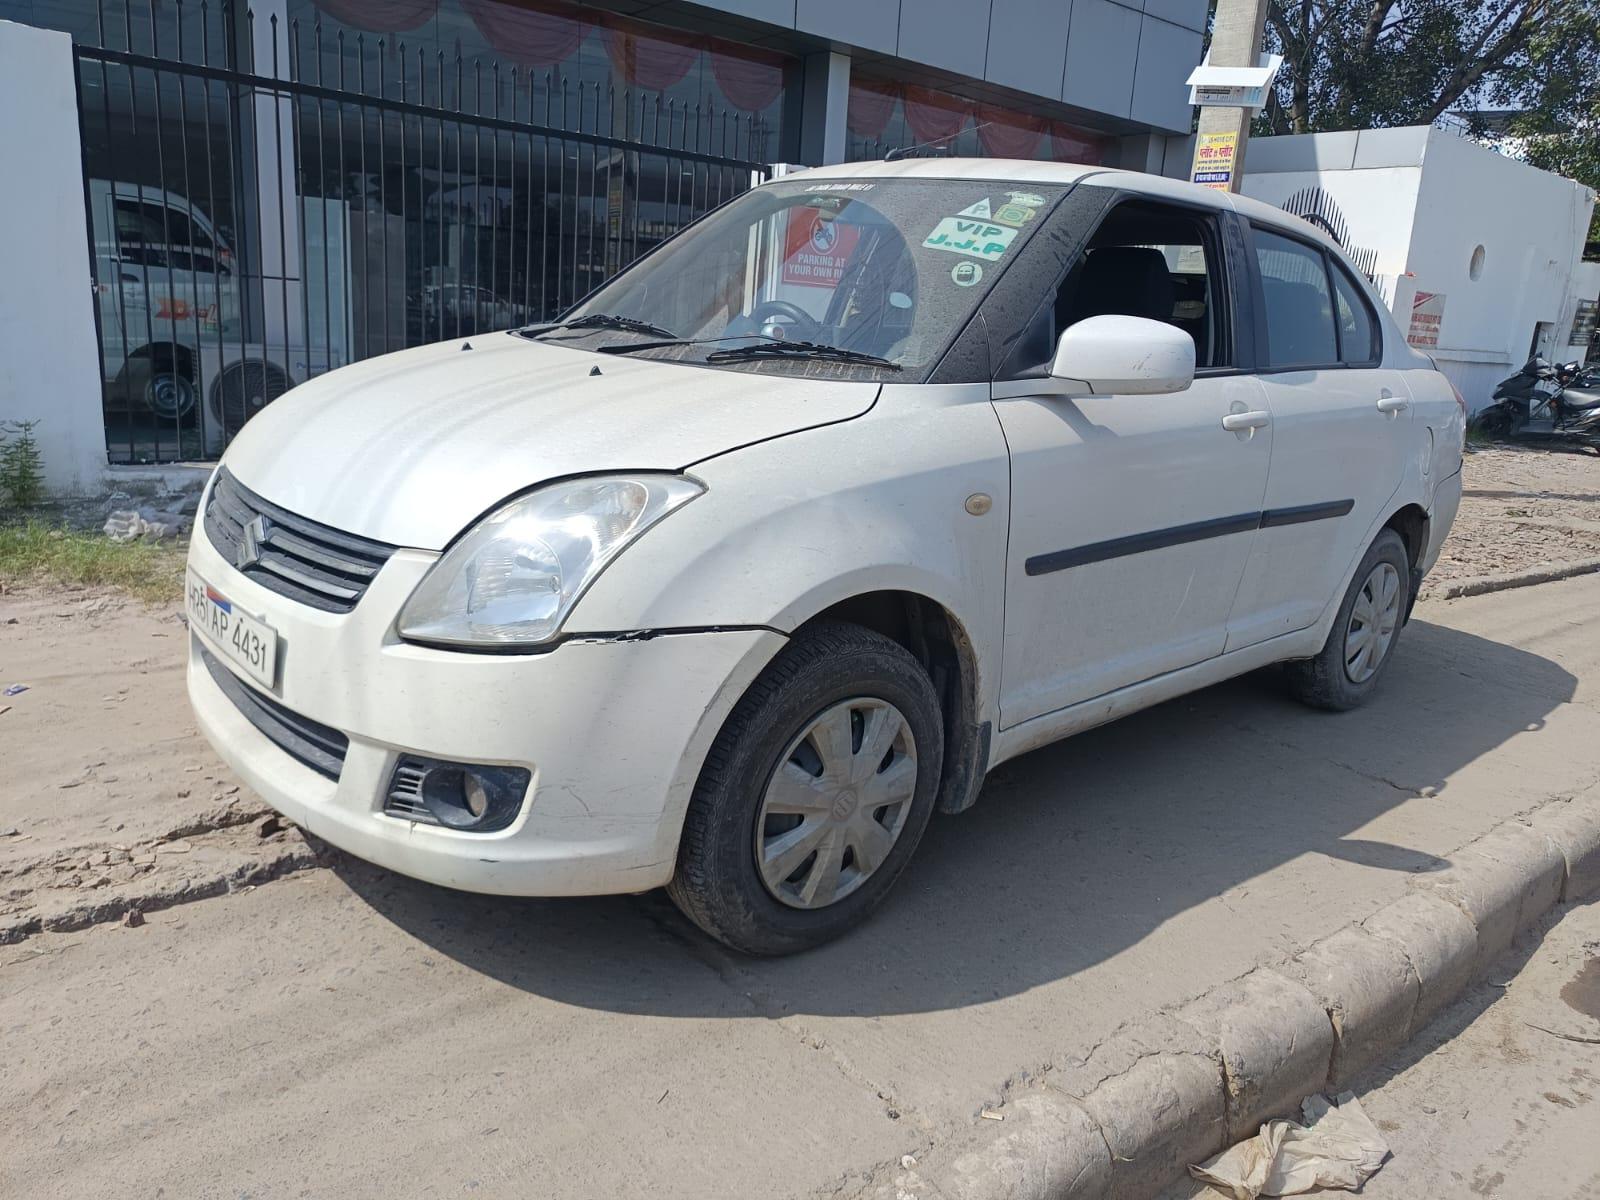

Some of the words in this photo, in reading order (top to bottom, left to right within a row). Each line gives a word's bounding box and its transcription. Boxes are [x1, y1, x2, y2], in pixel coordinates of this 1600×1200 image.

[957, 221, 1002, 237] VIP
[798, 254, 833, 266] PARKING
[834, 257, 846, 268] AT
[789, 264, 811, 275] YOUR
[813, 265, 832, 278] OWN
[833, 268, 843, 279] RI
[211, 605, 228, 641] AP
[232, 622, 266, 672] 4431
